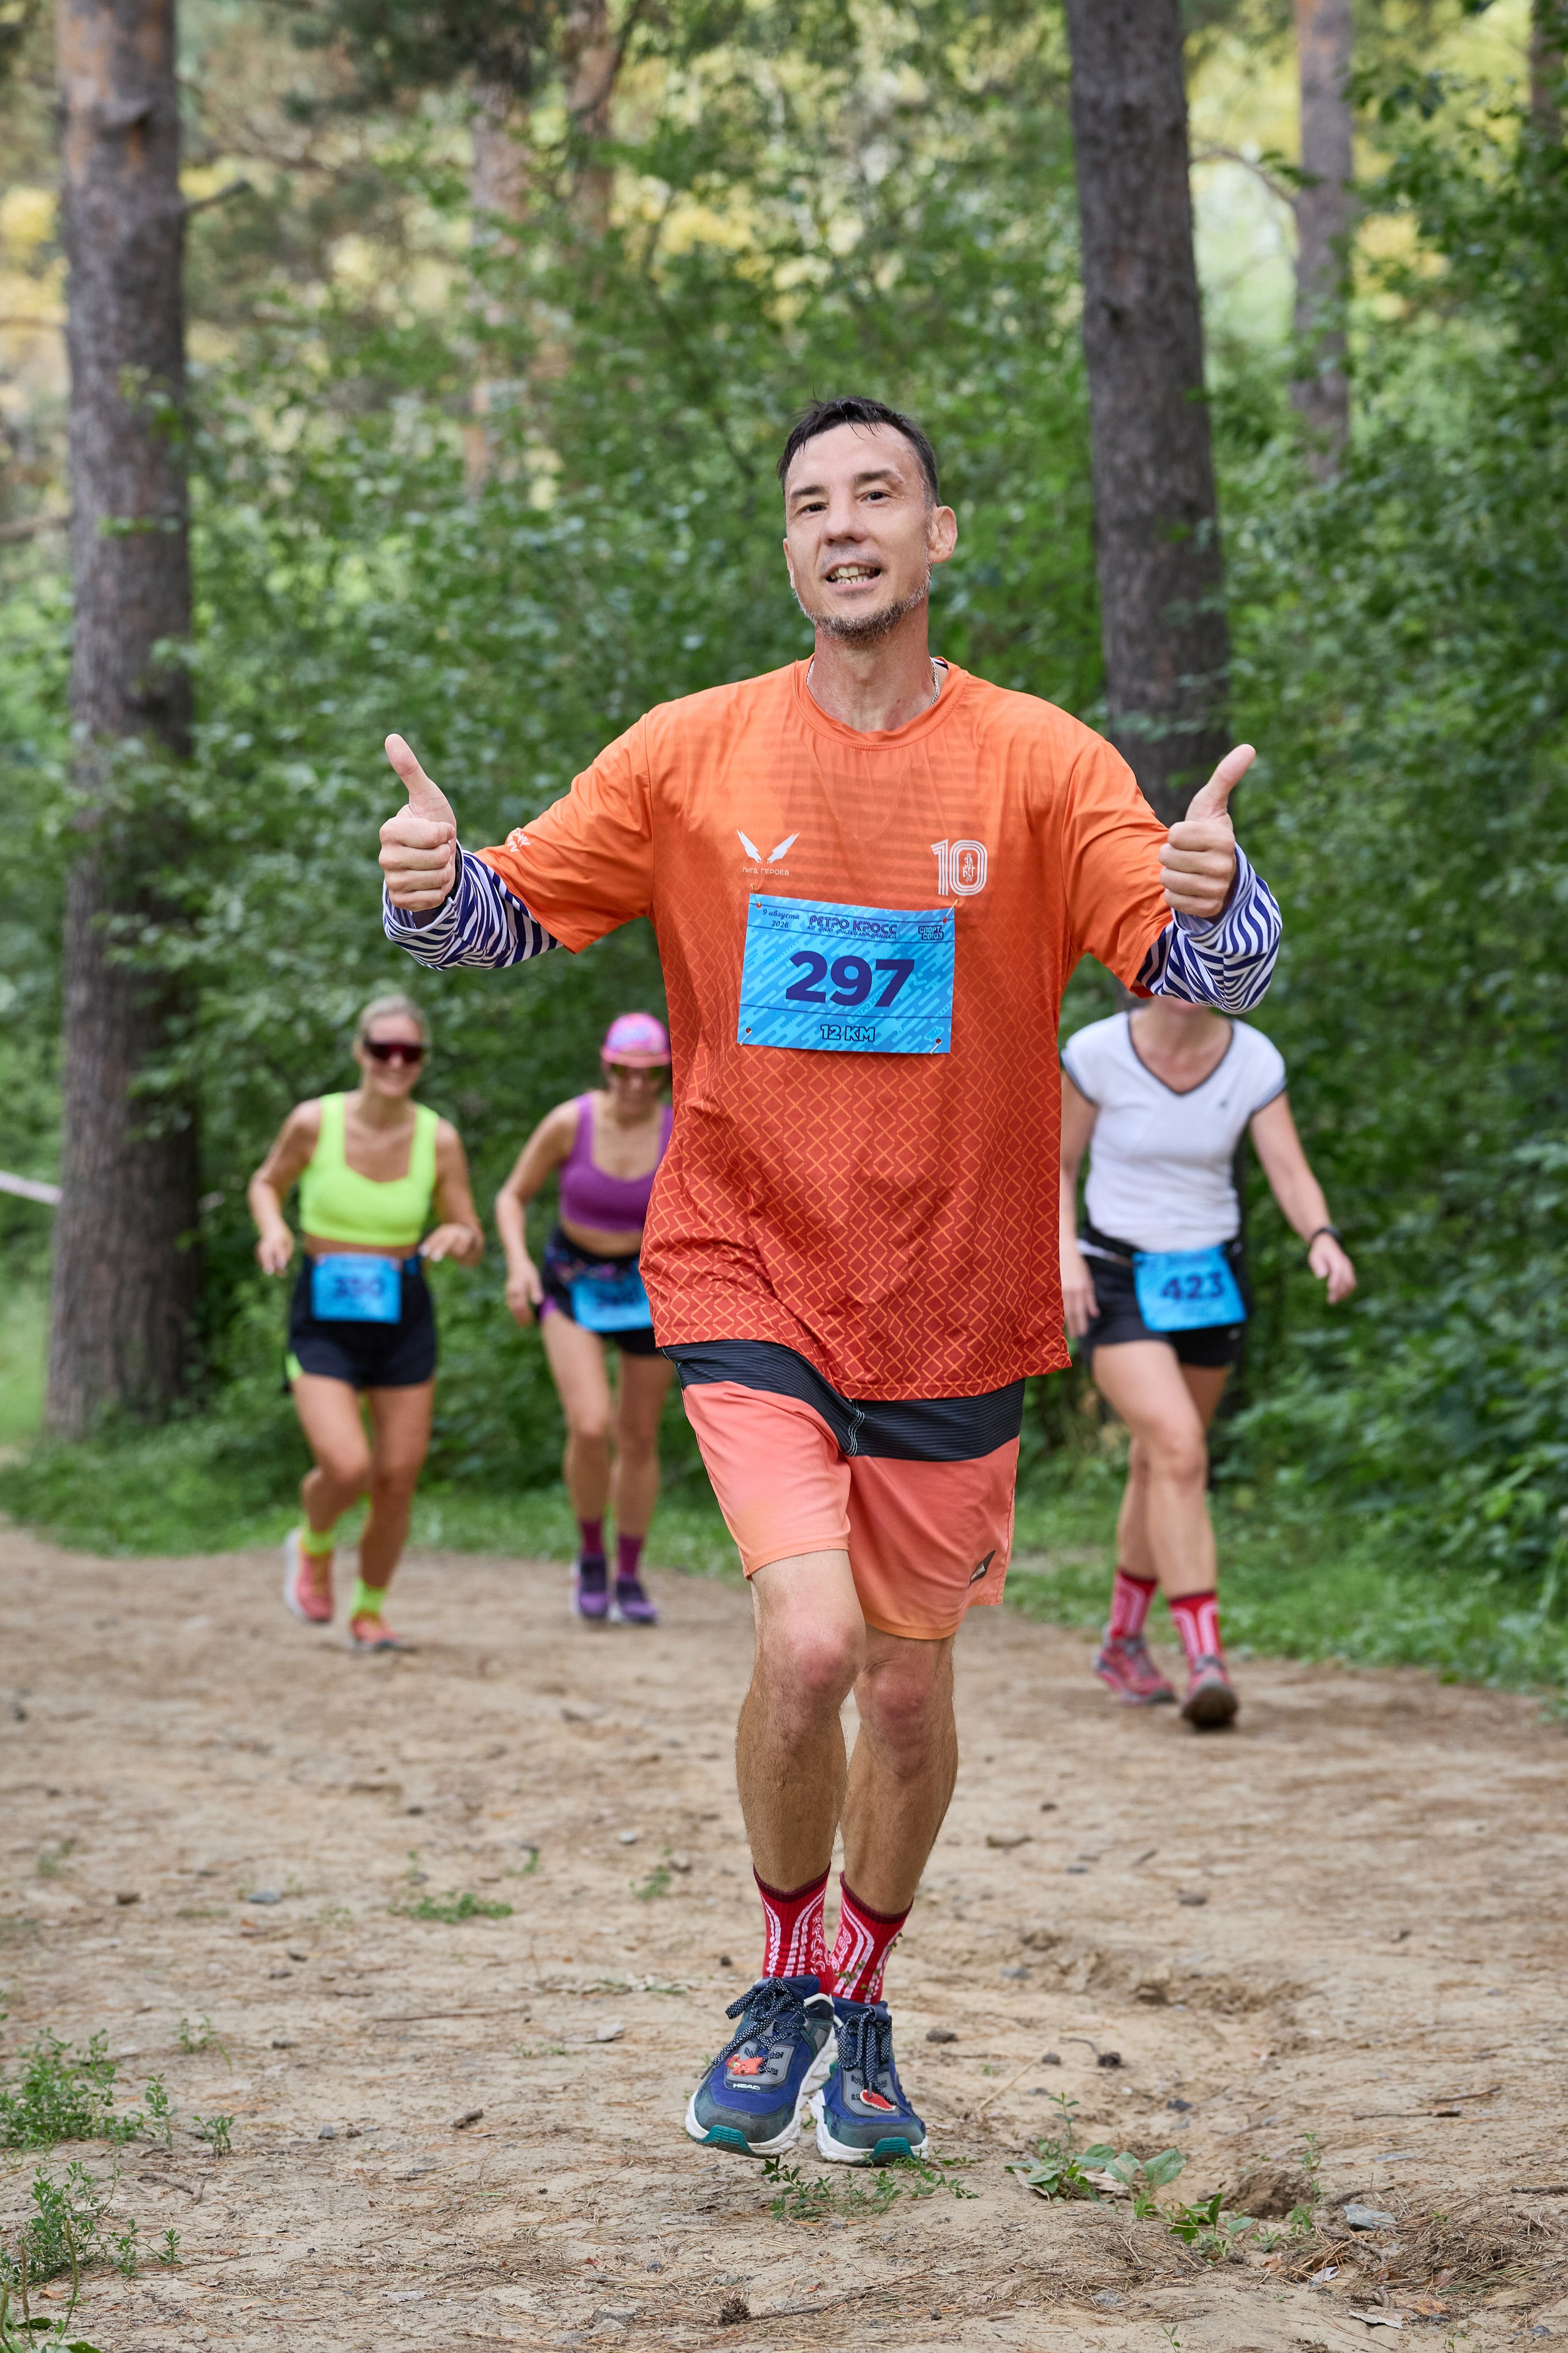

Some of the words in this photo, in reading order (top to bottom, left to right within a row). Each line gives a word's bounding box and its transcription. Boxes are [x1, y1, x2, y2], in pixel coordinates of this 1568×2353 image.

[930, 839, 988, 896] 10
[769, 910, 800, 920] августа
[809, 915, 850, 929] РЕТРО
[853, 920, 897, 935] КРОСС
[918, 925, 941, 934] СПОРТ
[921, 932, 944, 940] СОЮЗ
[785, 950, 915, 1008] 297
[820, 1024, 842, 1041] 12
[1161, 1271, 1226, 1301] 423
